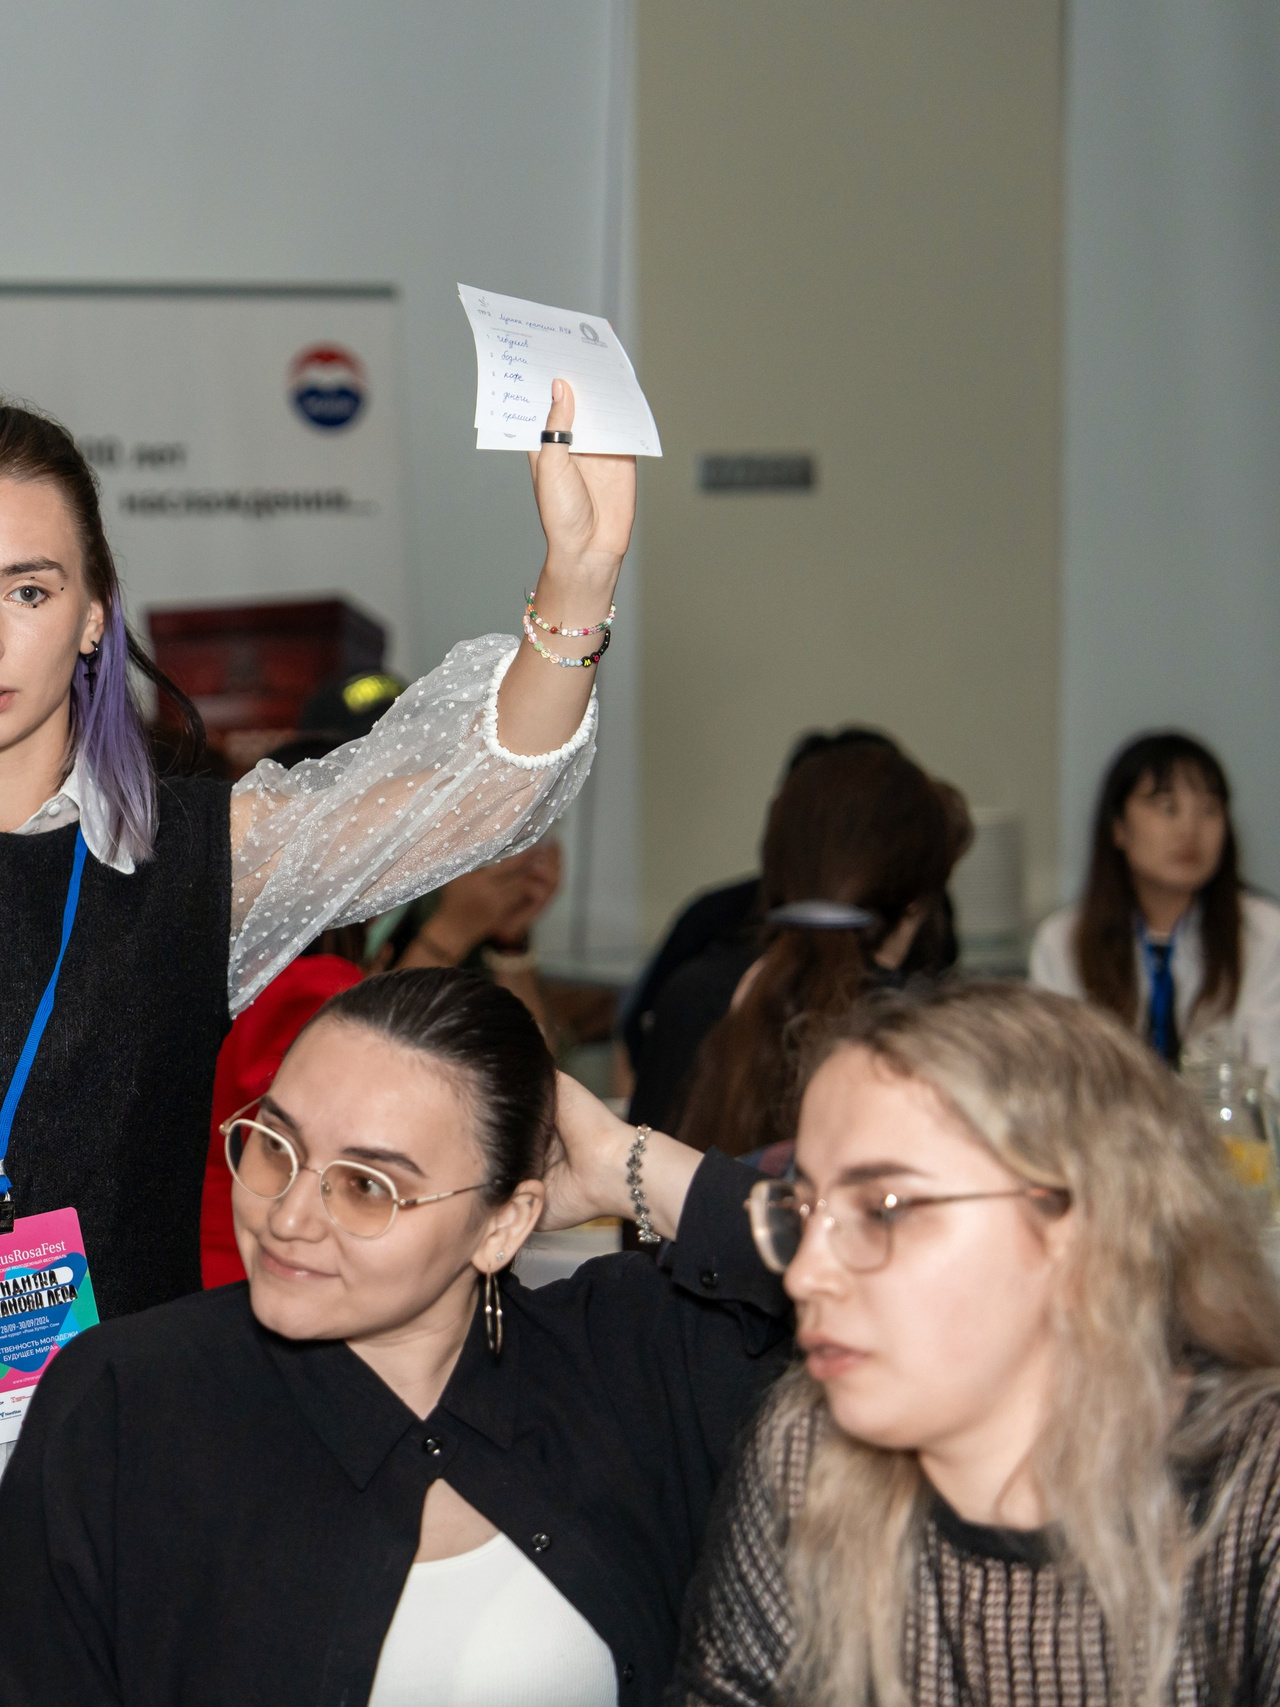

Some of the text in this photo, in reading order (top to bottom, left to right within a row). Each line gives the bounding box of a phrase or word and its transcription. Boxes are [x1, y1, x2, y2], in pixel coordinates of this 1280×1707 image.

[504, 372, 524, 382] кофе
[46, 1284, 78, 1307] ЛЕРА
[3, 1345, 58, 1362] БУДУЩЕЕ МИРА»
